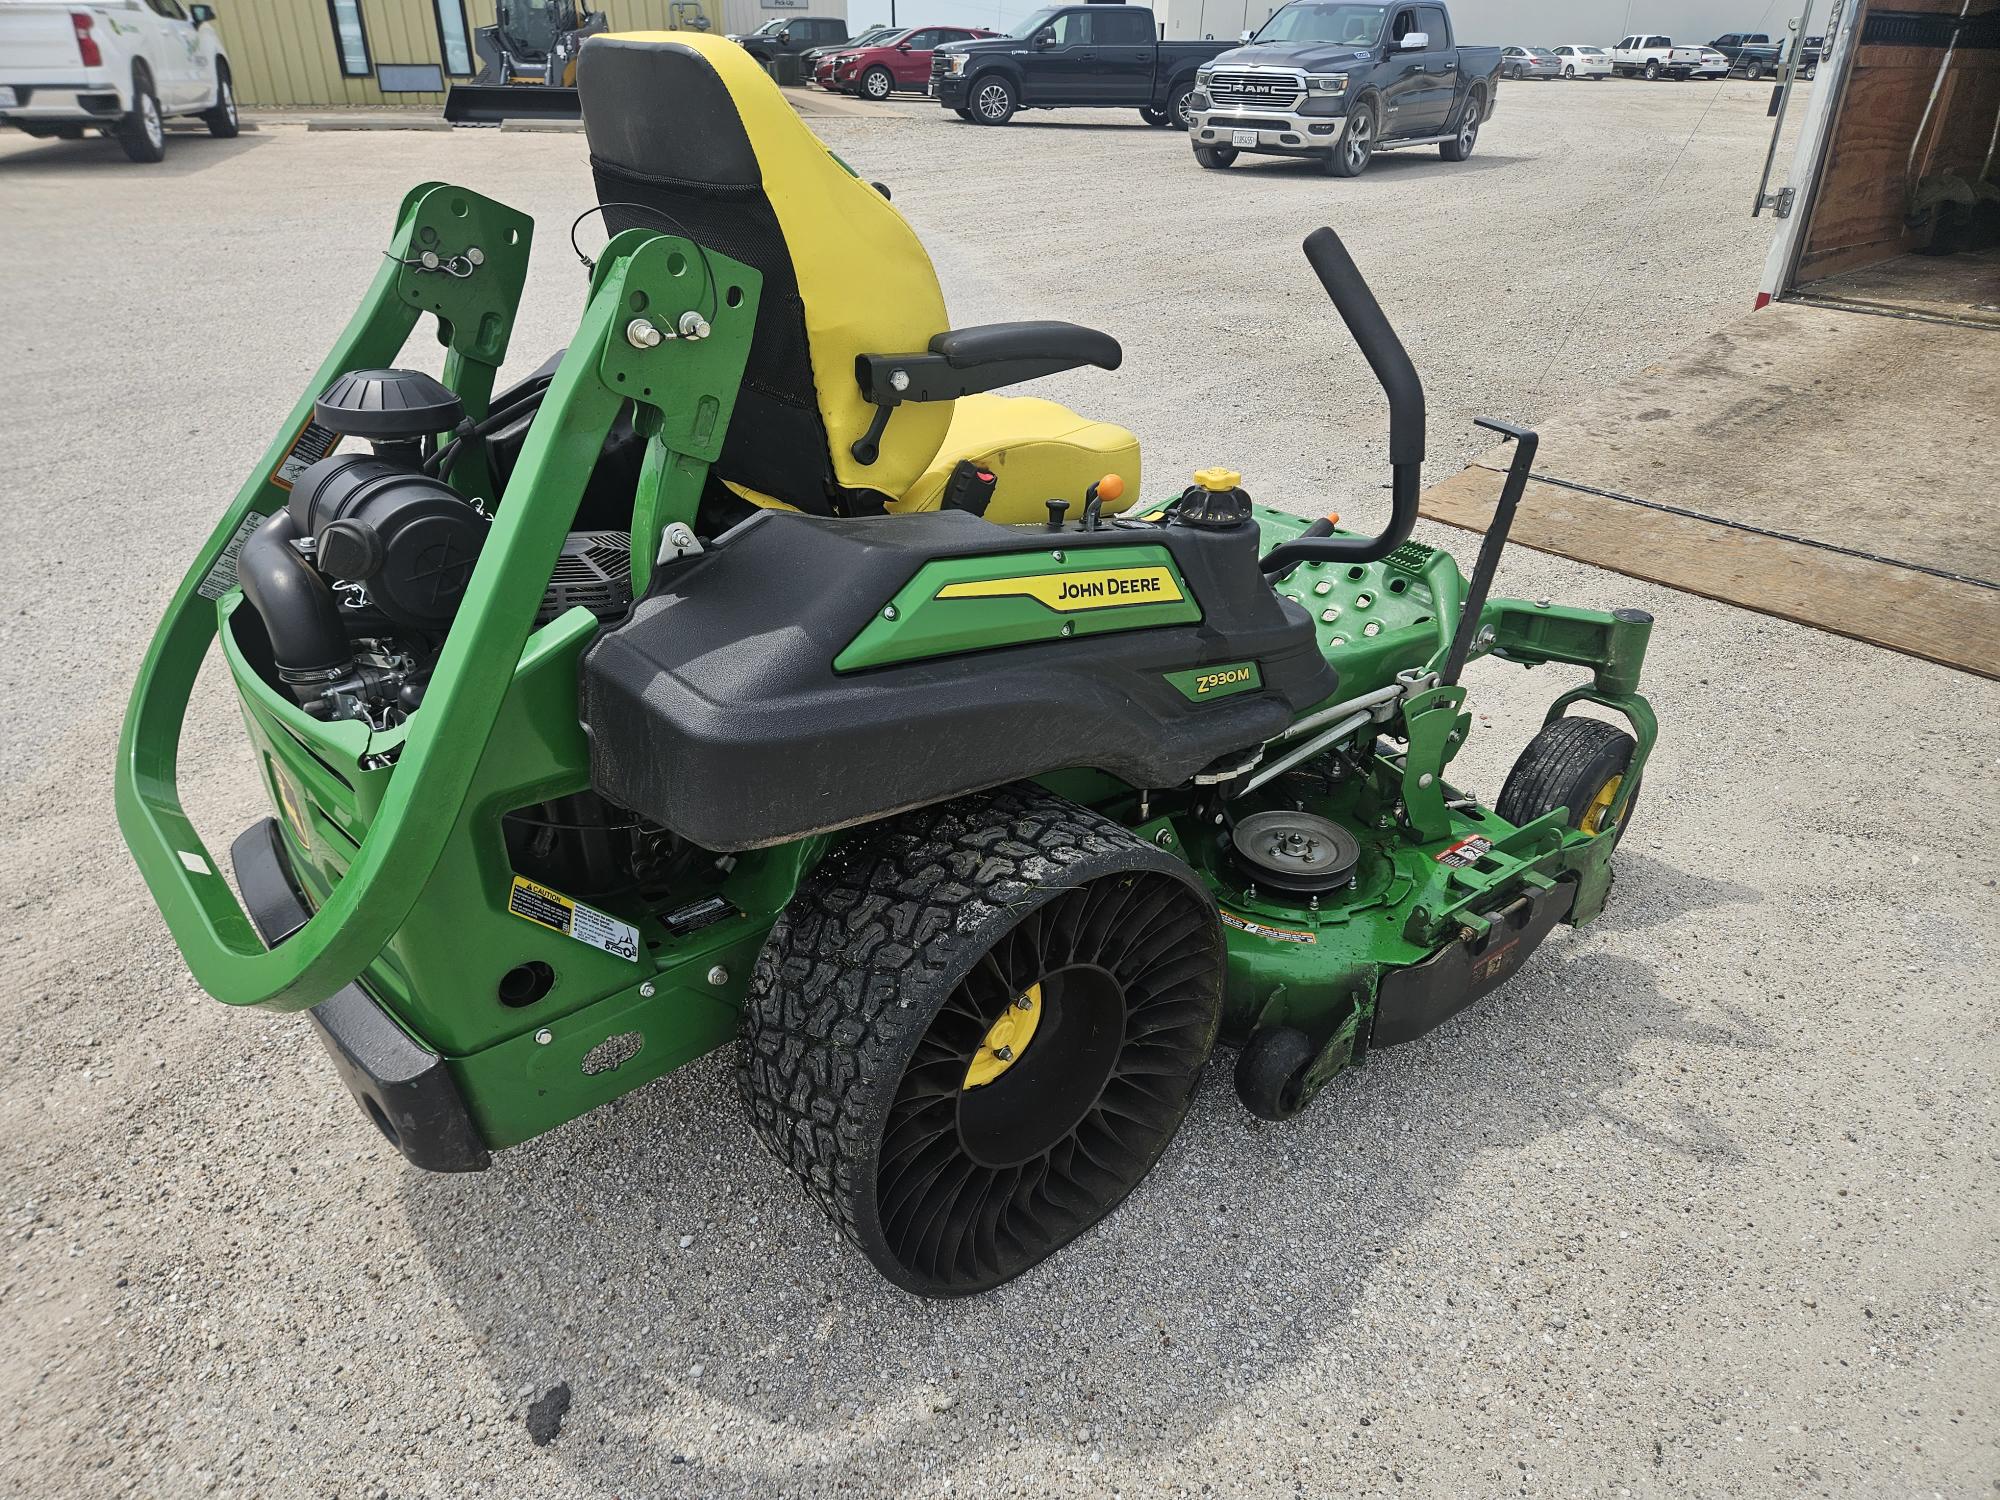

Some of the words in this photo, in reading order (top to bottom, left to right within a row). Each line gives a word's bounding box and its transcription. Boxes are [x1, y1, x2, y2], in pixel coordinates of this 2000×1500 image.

[1232, 84, 1269, 93] RAM
[1058, 582, 1104, 600] JOHN
[1107, 577, 1160, 595] DEERE
[1196, 667, 1250, 694] Z930M
[533, 886, 562, 904] CAUTION
